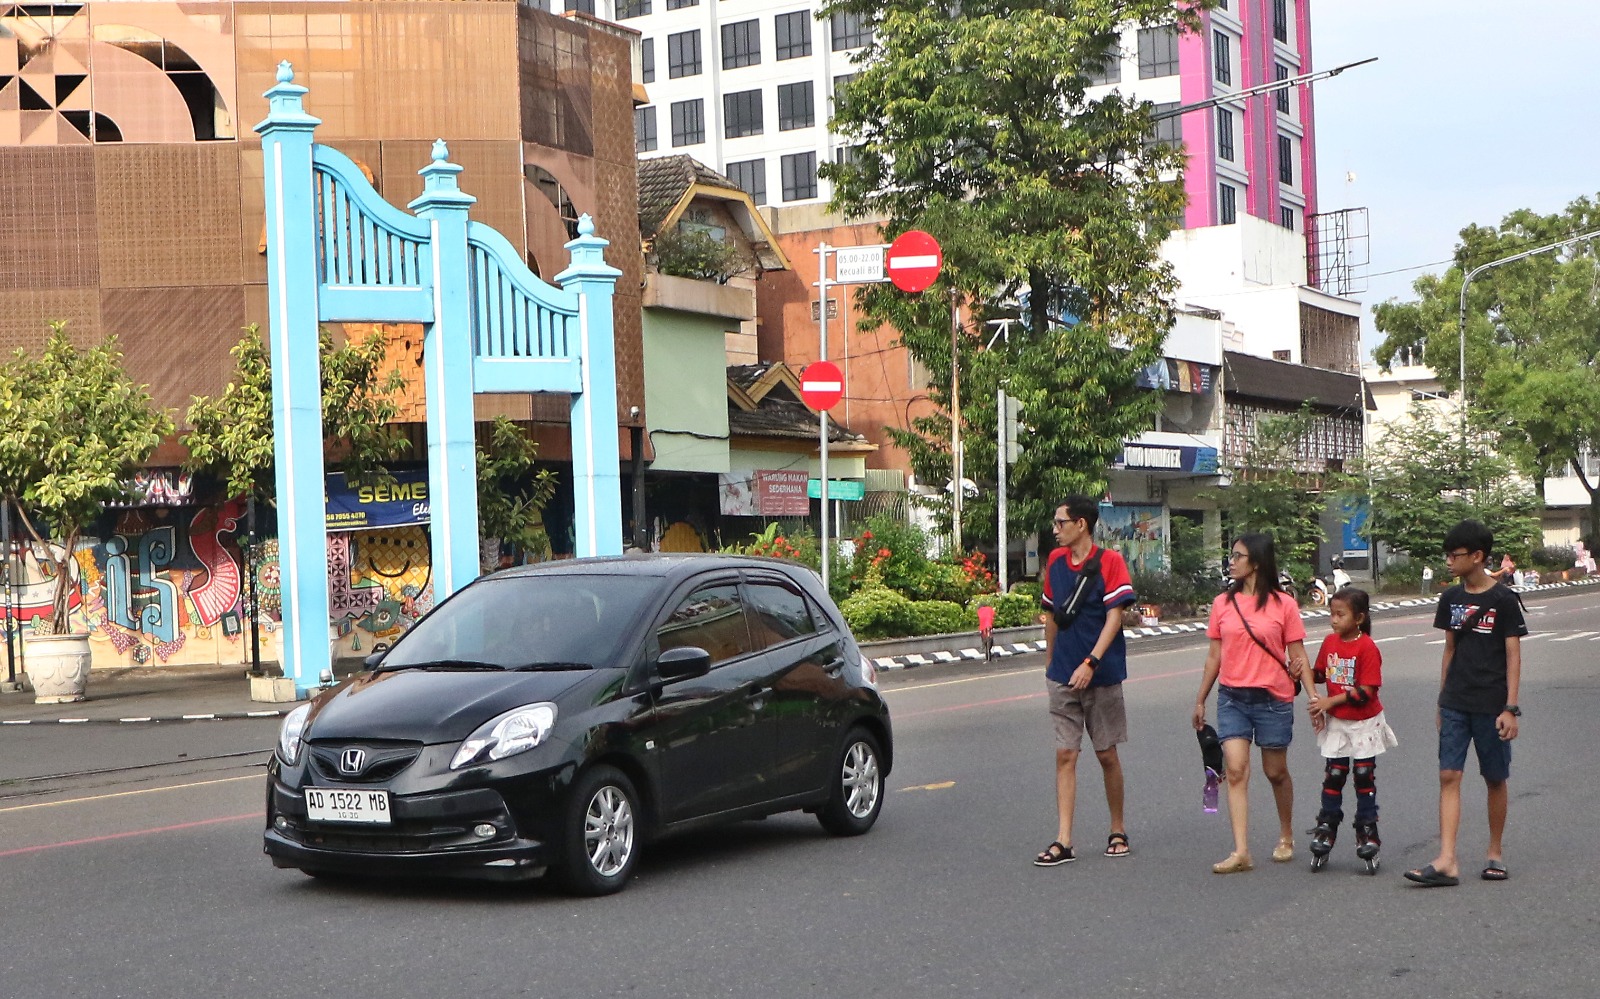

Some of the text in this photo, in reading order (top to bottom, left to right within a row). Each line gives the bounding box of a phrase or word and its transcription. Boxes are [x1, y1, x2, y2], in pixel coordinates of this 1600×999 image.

[838, 252, 880, 264] 05.00-22.00
[839, 266, 865, 276] Kecuali
[358, 482, 427, 503] SEME
[309, 791, 387, 811] AD 1522 MB
